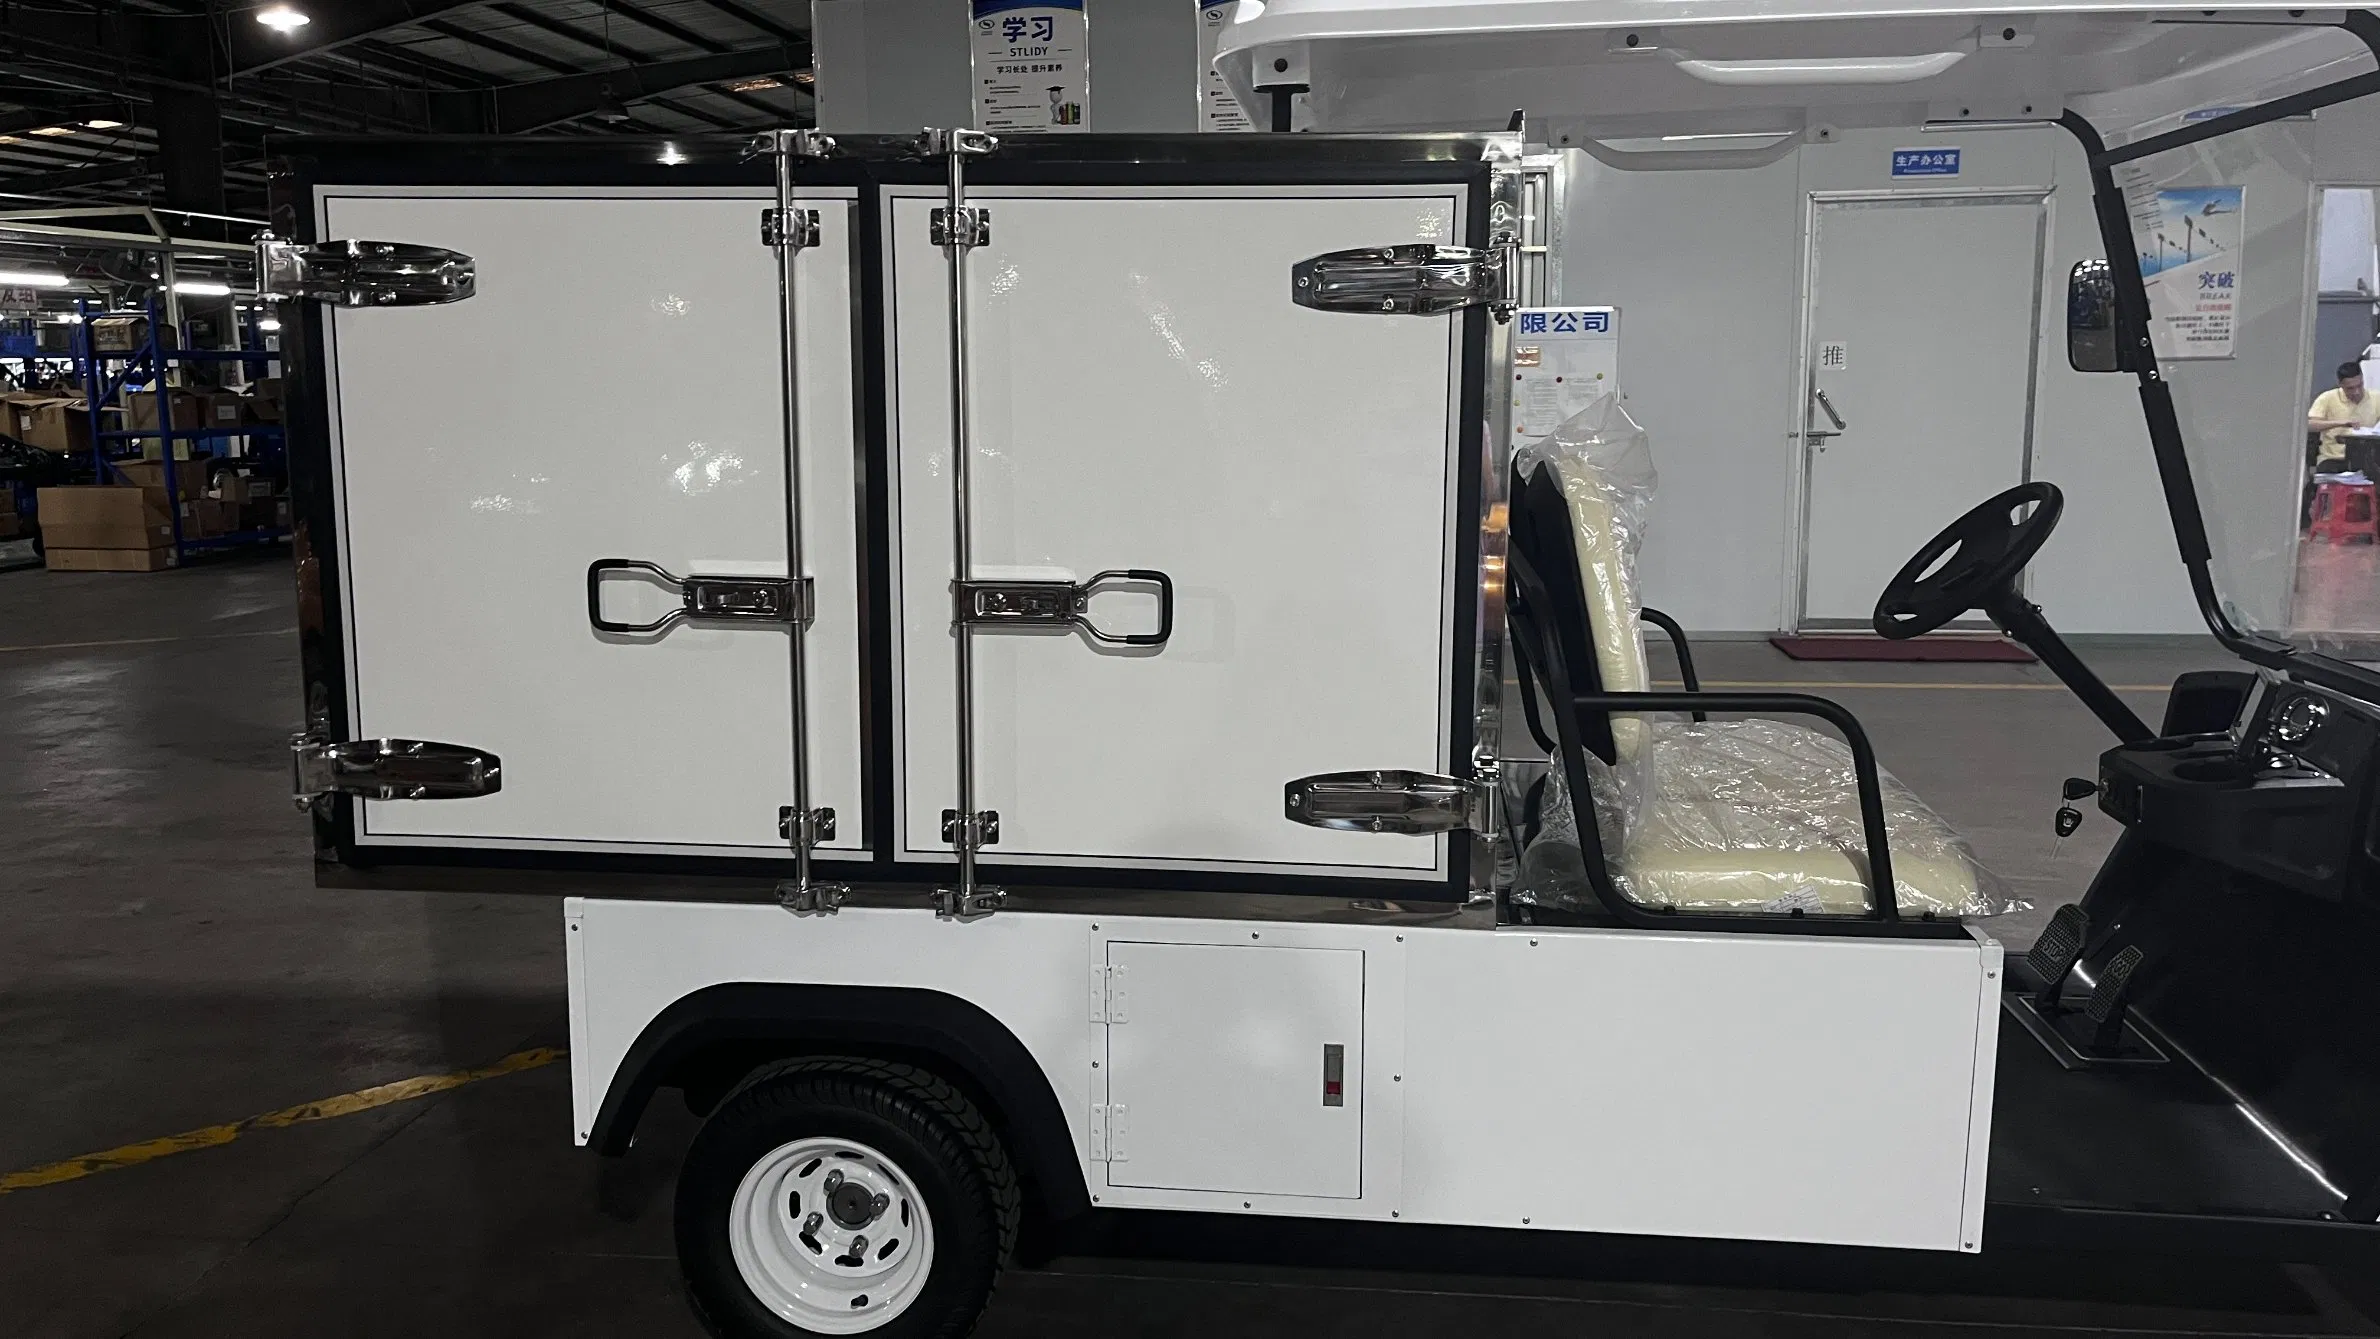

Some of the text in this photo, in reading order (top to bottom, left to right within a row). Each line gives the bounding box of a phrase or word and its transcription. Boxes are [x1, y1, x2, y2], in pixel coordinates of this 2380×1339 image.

[1002, 16, 1053, 43] 学习
[1895, 154, 1957, 167] 生产办公室
[2198, 271, 2235, 290] 突破
[1520, 312, 1609, 334] 限公司
[1822, 345, 1844, 366] 推
